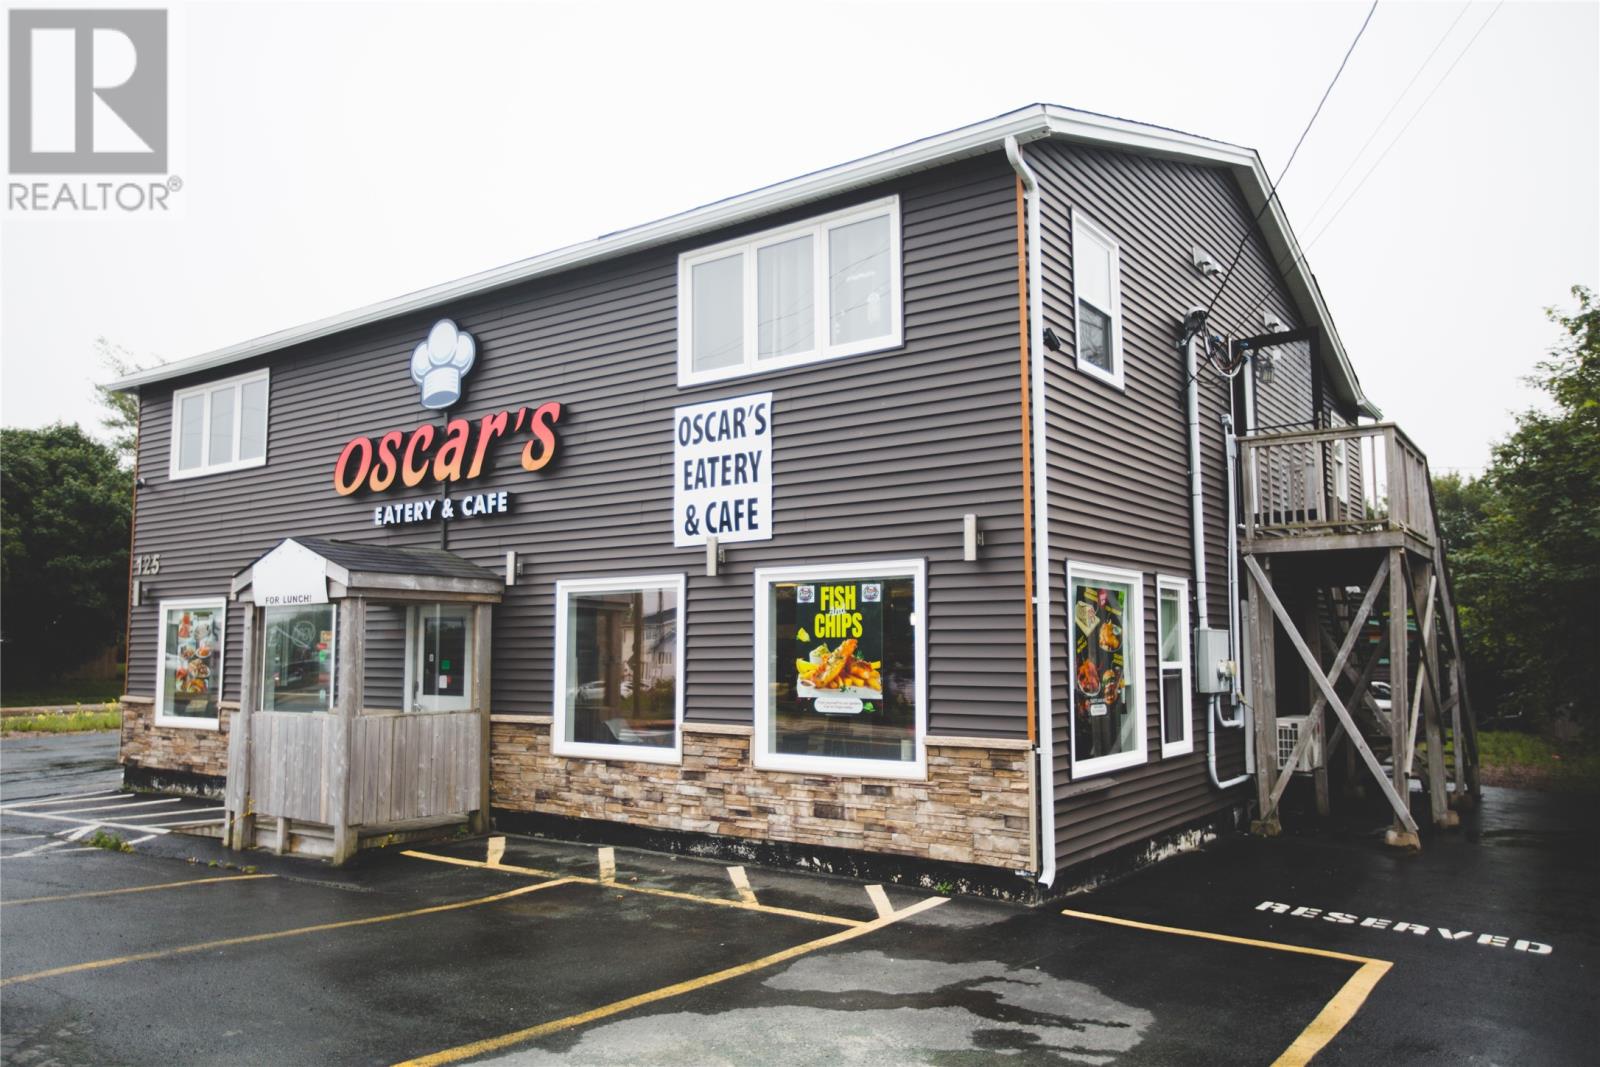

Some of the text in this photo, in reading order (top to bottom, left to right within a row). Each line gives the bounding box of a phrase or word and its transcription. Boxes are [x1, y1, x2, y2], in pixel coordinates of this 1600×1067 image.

[678, 402, 767, 447] OSCAR'S
[684, 450, 762, 491] EATERY
[374, 491, 508, 526] EATERY & CAFE
[684, 497, 759, 536] & CAFE
[136, 554, 160, 576] 125
[265, 594, 312, 605] FOR LUNCH!
[820, 585, 856, 611] FISH
[814, 612, 863, 638] CHIPS
[1255, 901, 1553, 955] RESERVED
